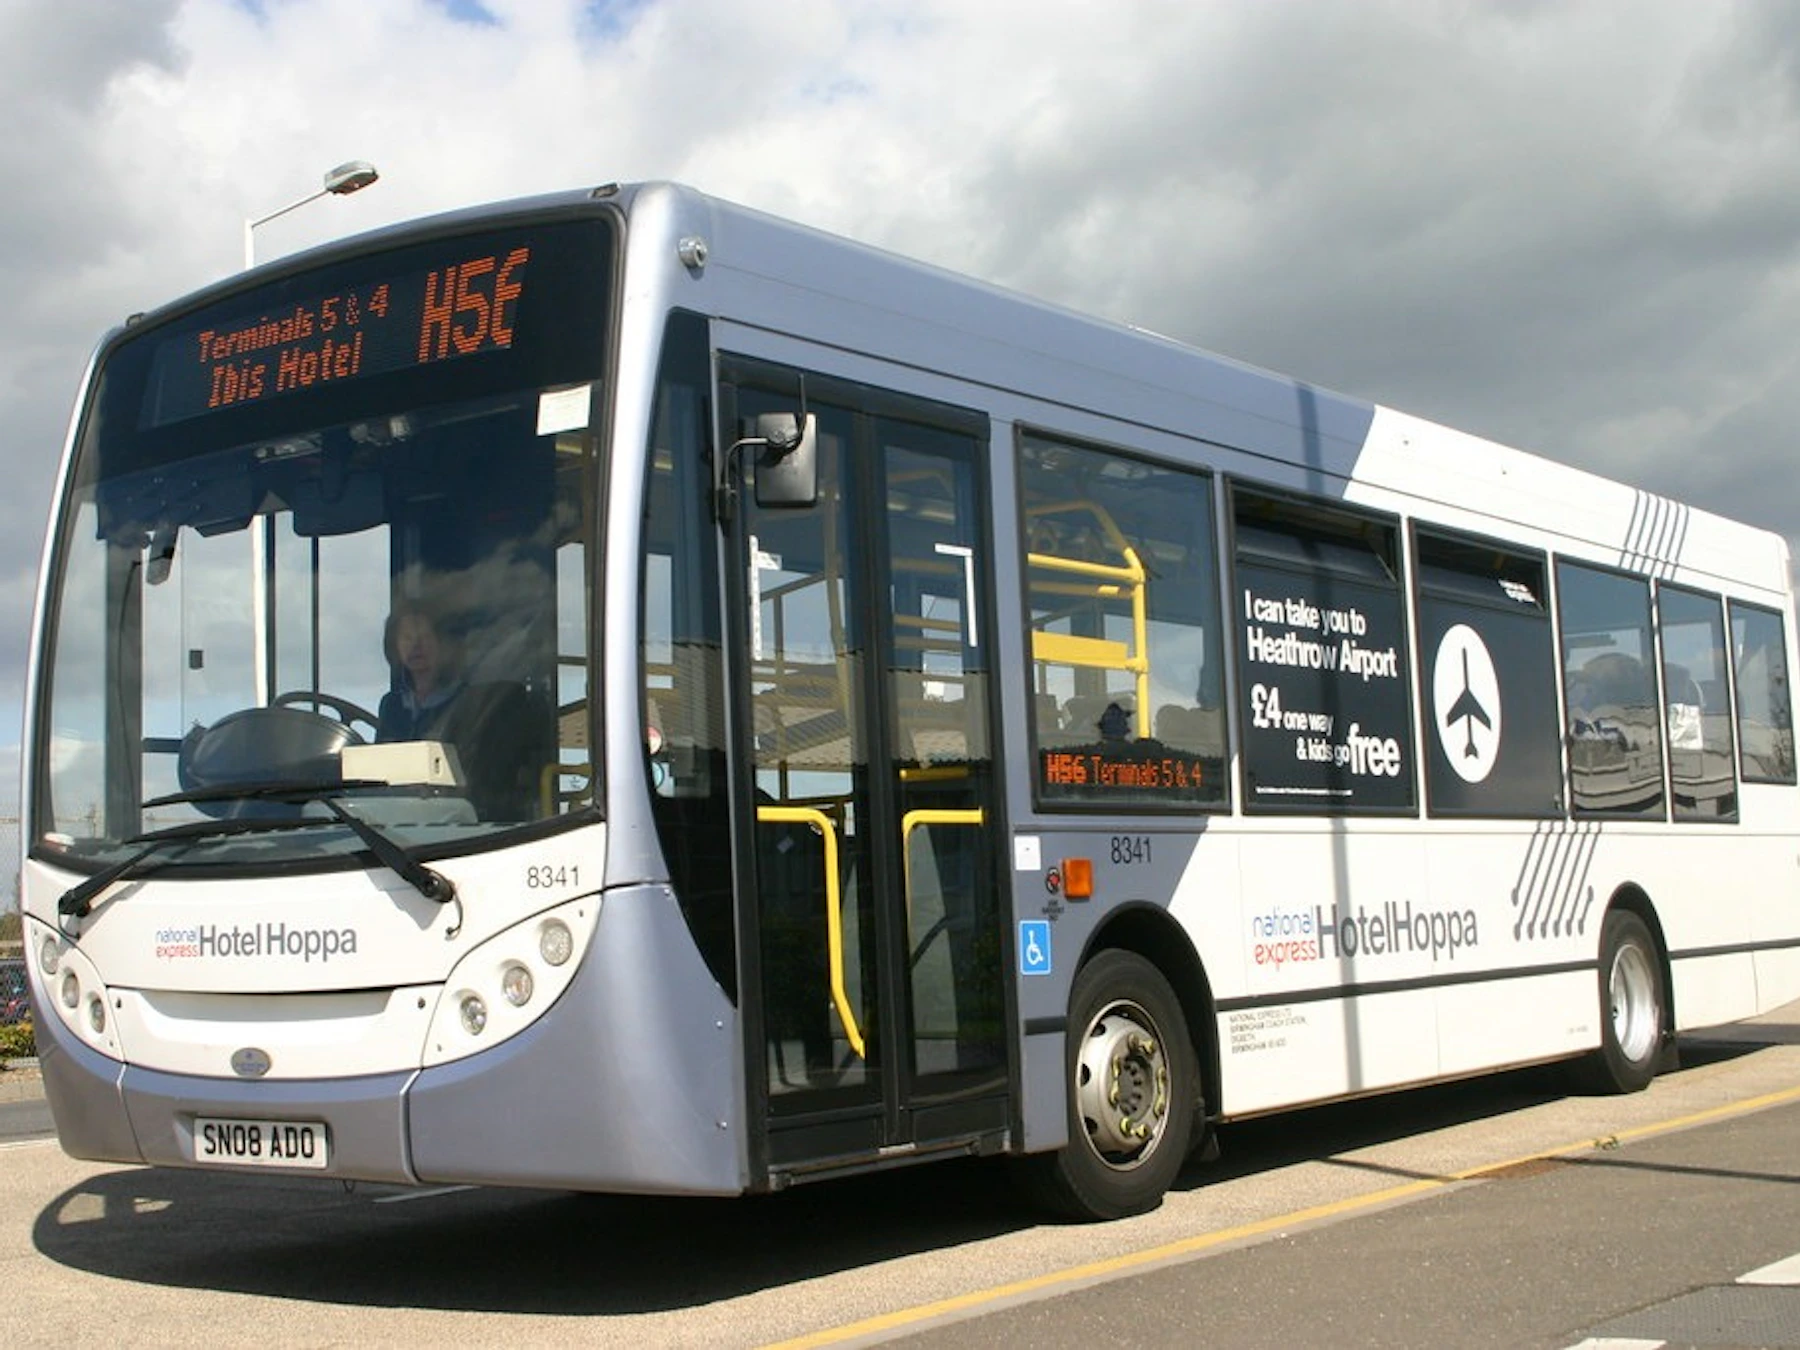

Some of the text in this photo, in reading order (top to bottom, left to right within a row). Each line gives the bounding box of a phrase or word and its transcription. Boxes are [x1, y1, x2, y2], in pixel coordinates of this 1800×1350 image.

[199, 284, 389, 363] Terminals 5 & 4
[208, 331, 363, 408] Ibis Hotel
[1244, 589, 1366, 636] I can take you to
[1246, 626, 1397, 681] Heathrow Airport
[1251, 683, 1333, 736] £4 one way
[1296, 722, 1401, 777] & kids go free
[1047, 753, 1202, 788] H56 Terminals 5 & 4
[1111, 836, 1151, 864] 8341
[527, 865, 580, 888] 8341
[156, 927, 198, 943] national
[1253, 905, 1315, 938] national
[156, 944, 198, 963] express
[199, 922, 357, 963] Hotel Hoppa
[1255, 938, 1317, 971] express
[204, 1124, 314, 1159] SN08 ADO
